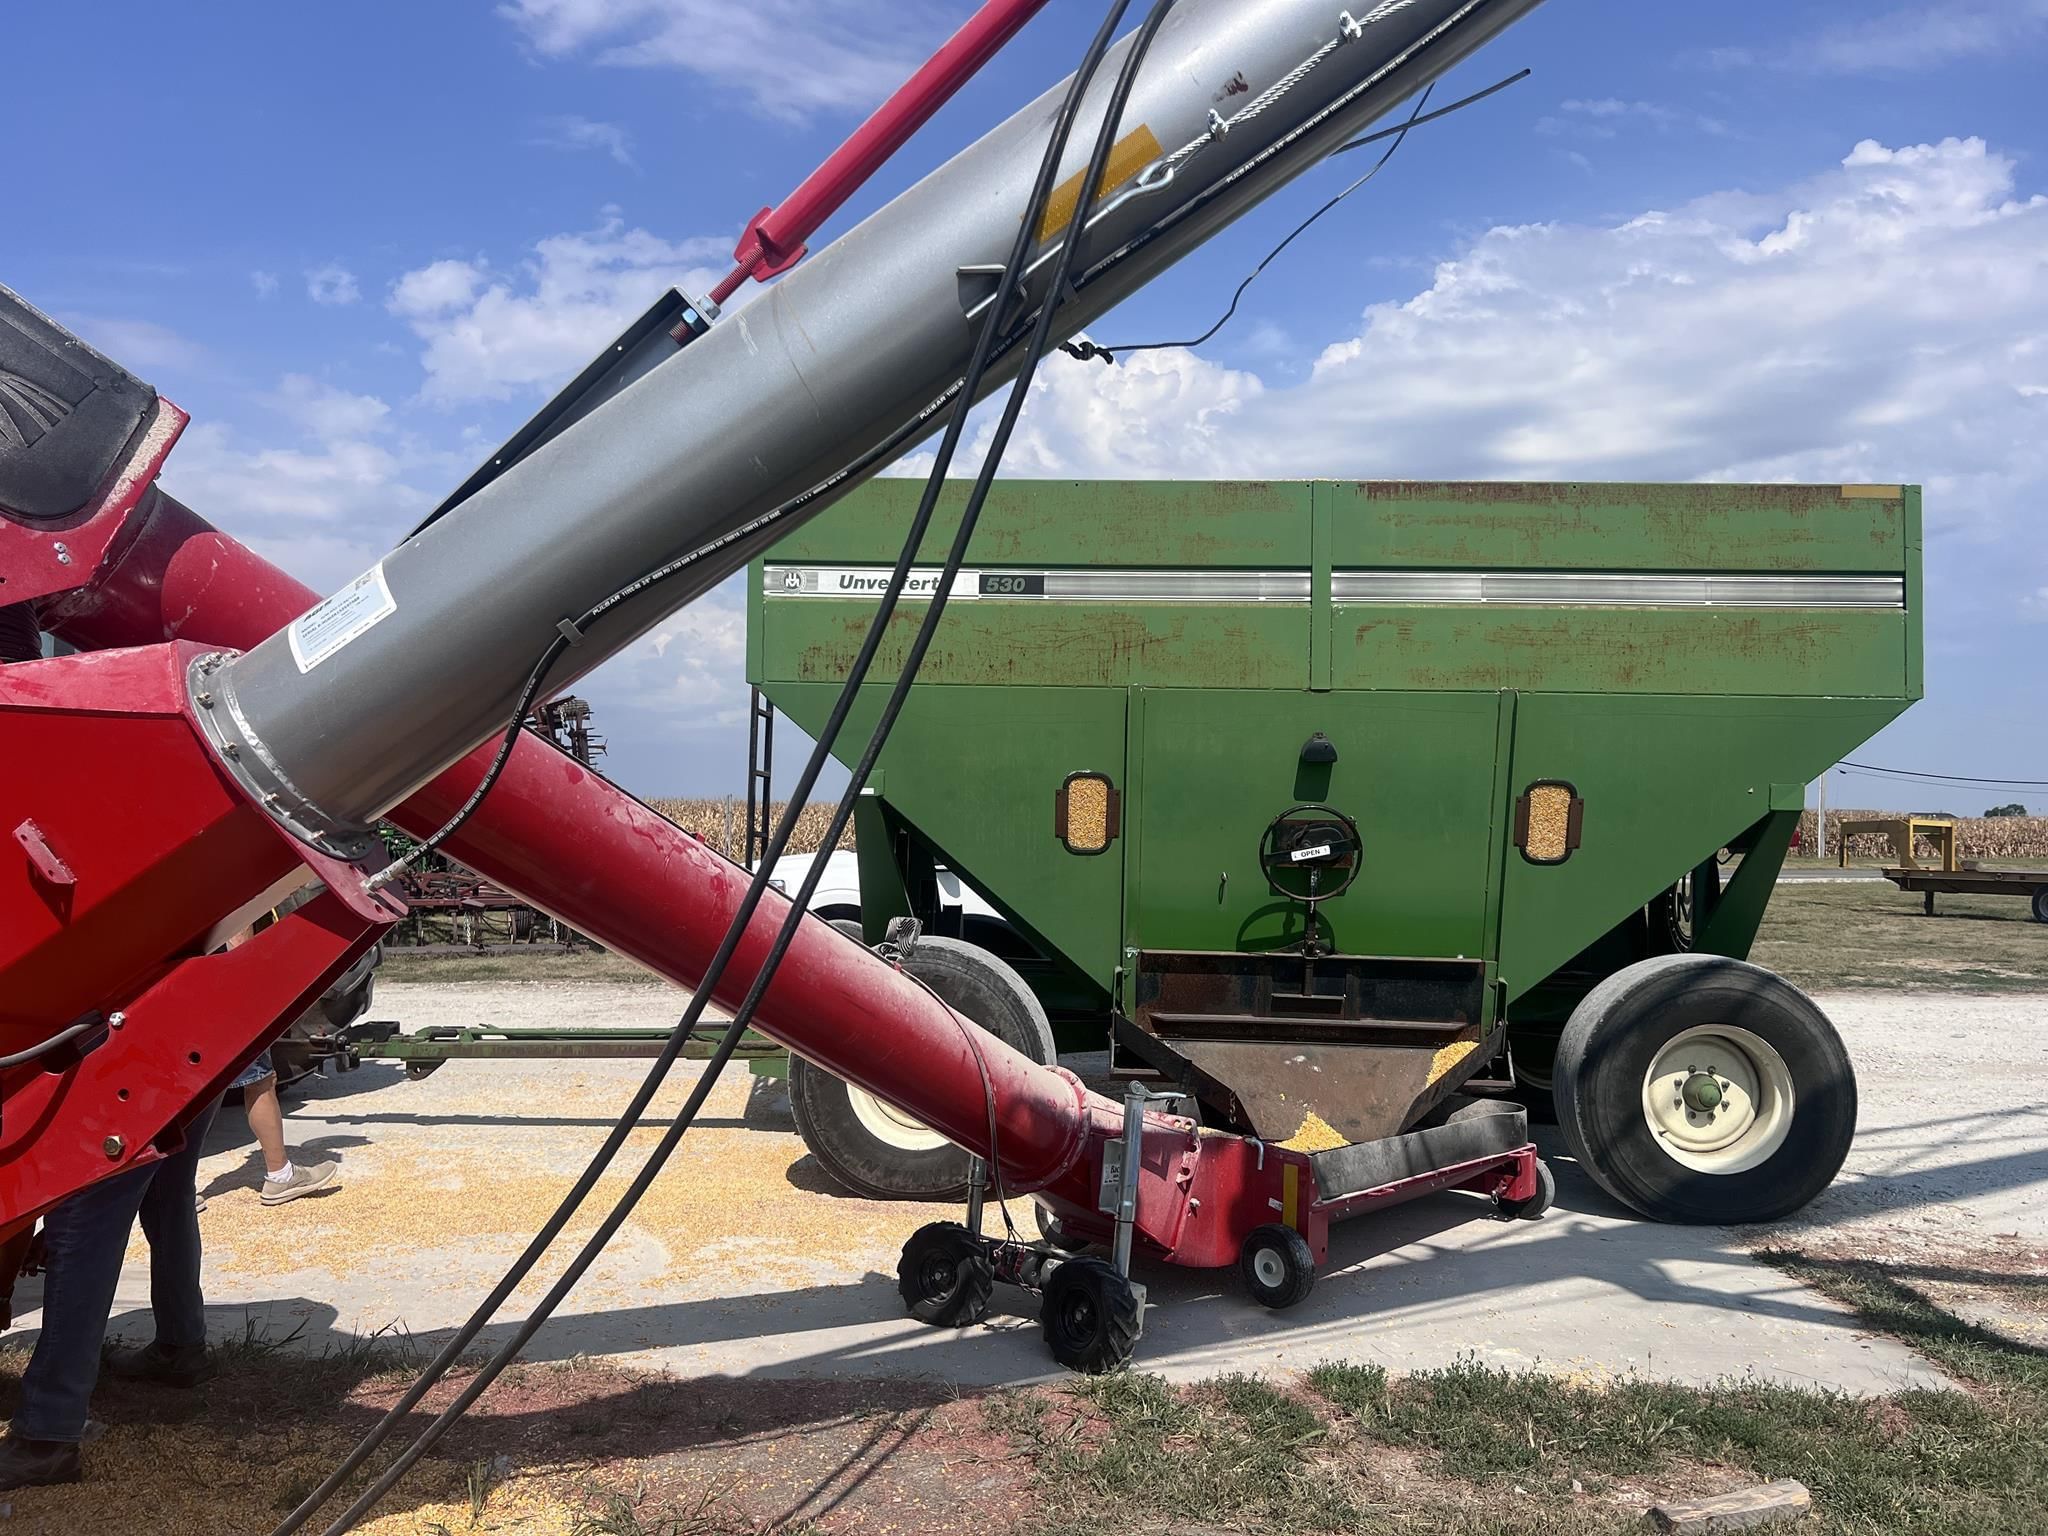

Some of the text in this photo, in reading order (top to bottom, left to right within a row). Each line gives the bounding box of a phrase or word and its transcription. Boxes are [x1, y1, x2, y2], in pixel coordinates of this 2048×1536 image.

[839, 575, 940, 590] Unvefert
[986, 577, 1026, 592] 530
[592, 594, 620, 616] PULSAR
[1300, 849, 1320, 857] OPEN
